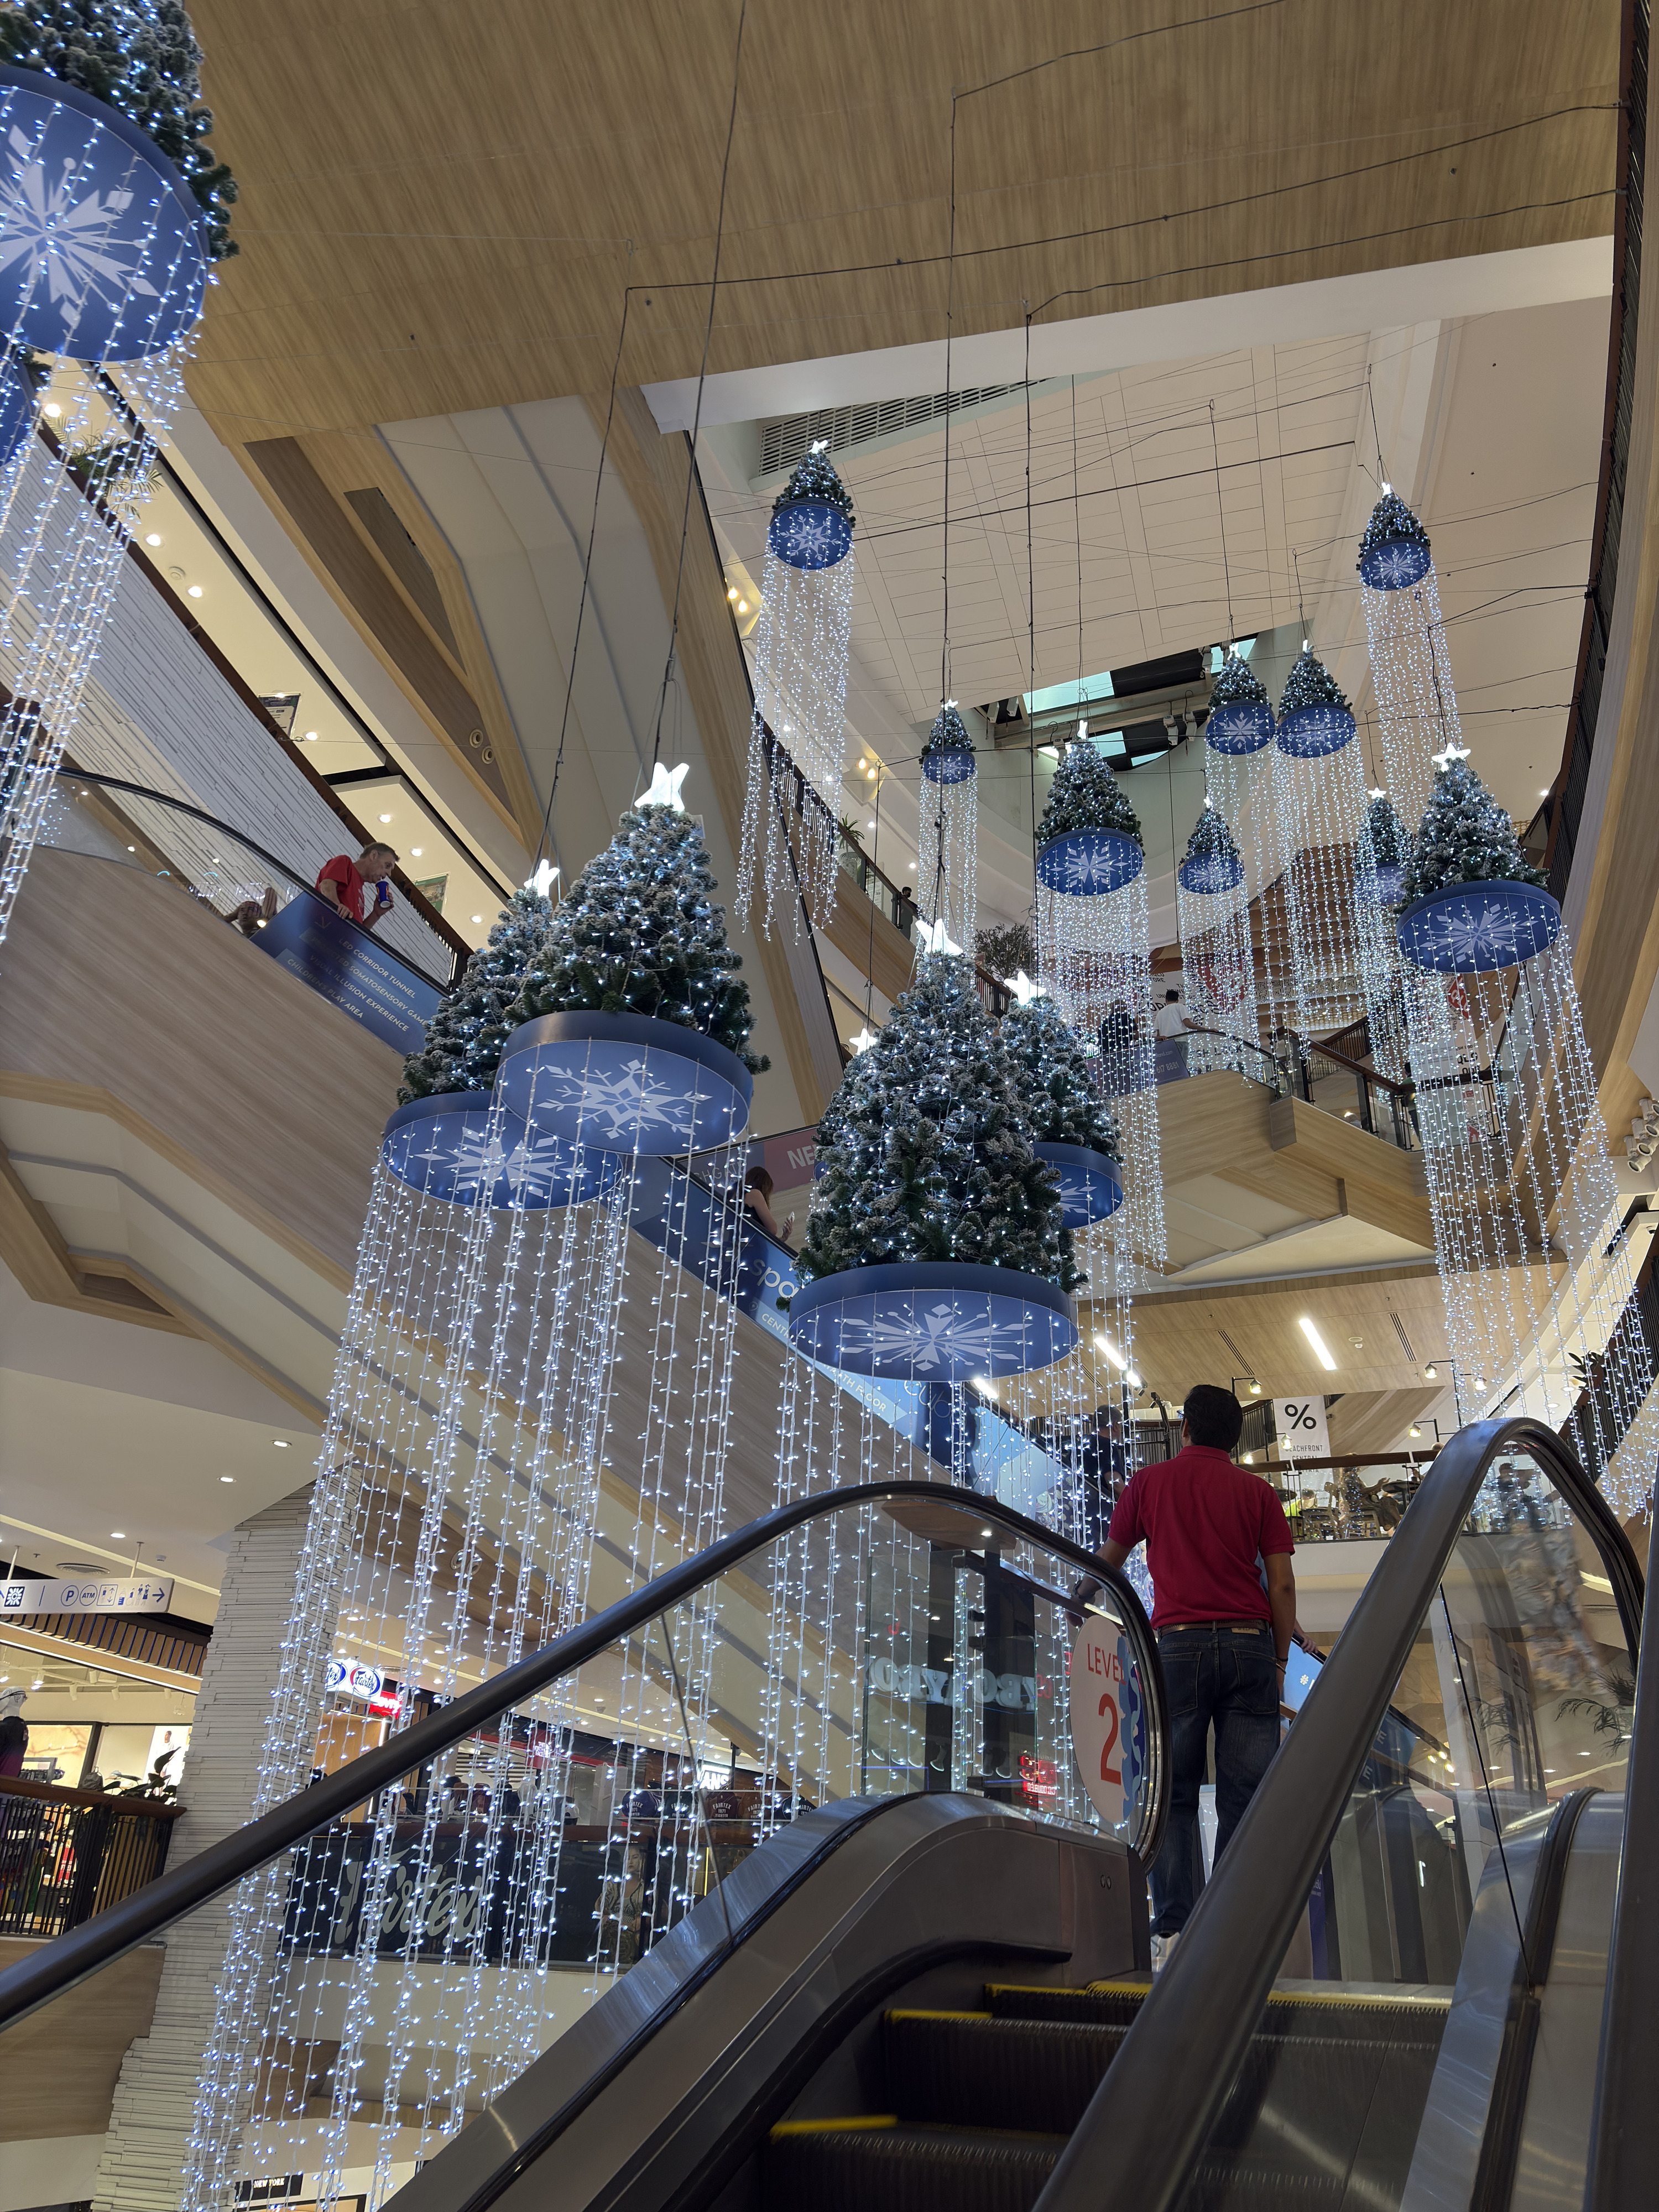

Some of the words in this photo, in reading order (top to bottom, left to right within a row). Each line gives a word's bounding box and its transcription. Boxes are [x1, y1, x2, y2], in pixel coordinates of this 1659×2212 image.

[338, 938, 353, 950] LED
[353, 949, 389, 977] CORRIDOR
[389, 975, 416, 998] TUNNEL
[349, 966, 408, 1010] SOMATOSENSORY
[327, 988, 346, 1003] PLAY
[344, 1003, 363, 1018] AREA
[334, 974, 367, 1000] ILLUSION
[366, 998, 409, 1031] EXPERIENCE
[66, 1590, 75, 1601] P
[355, 1671, 375, 1691] Fairtex
[1087, 1643, 1127, 1685] LEVEL
[1098, 1693, 1121, 1786] 2
[335, 1848, 482, 1947] Firtex
[254, 2179, 268, 2189] NEW
[269, 2178, 285, 2187] YORK
